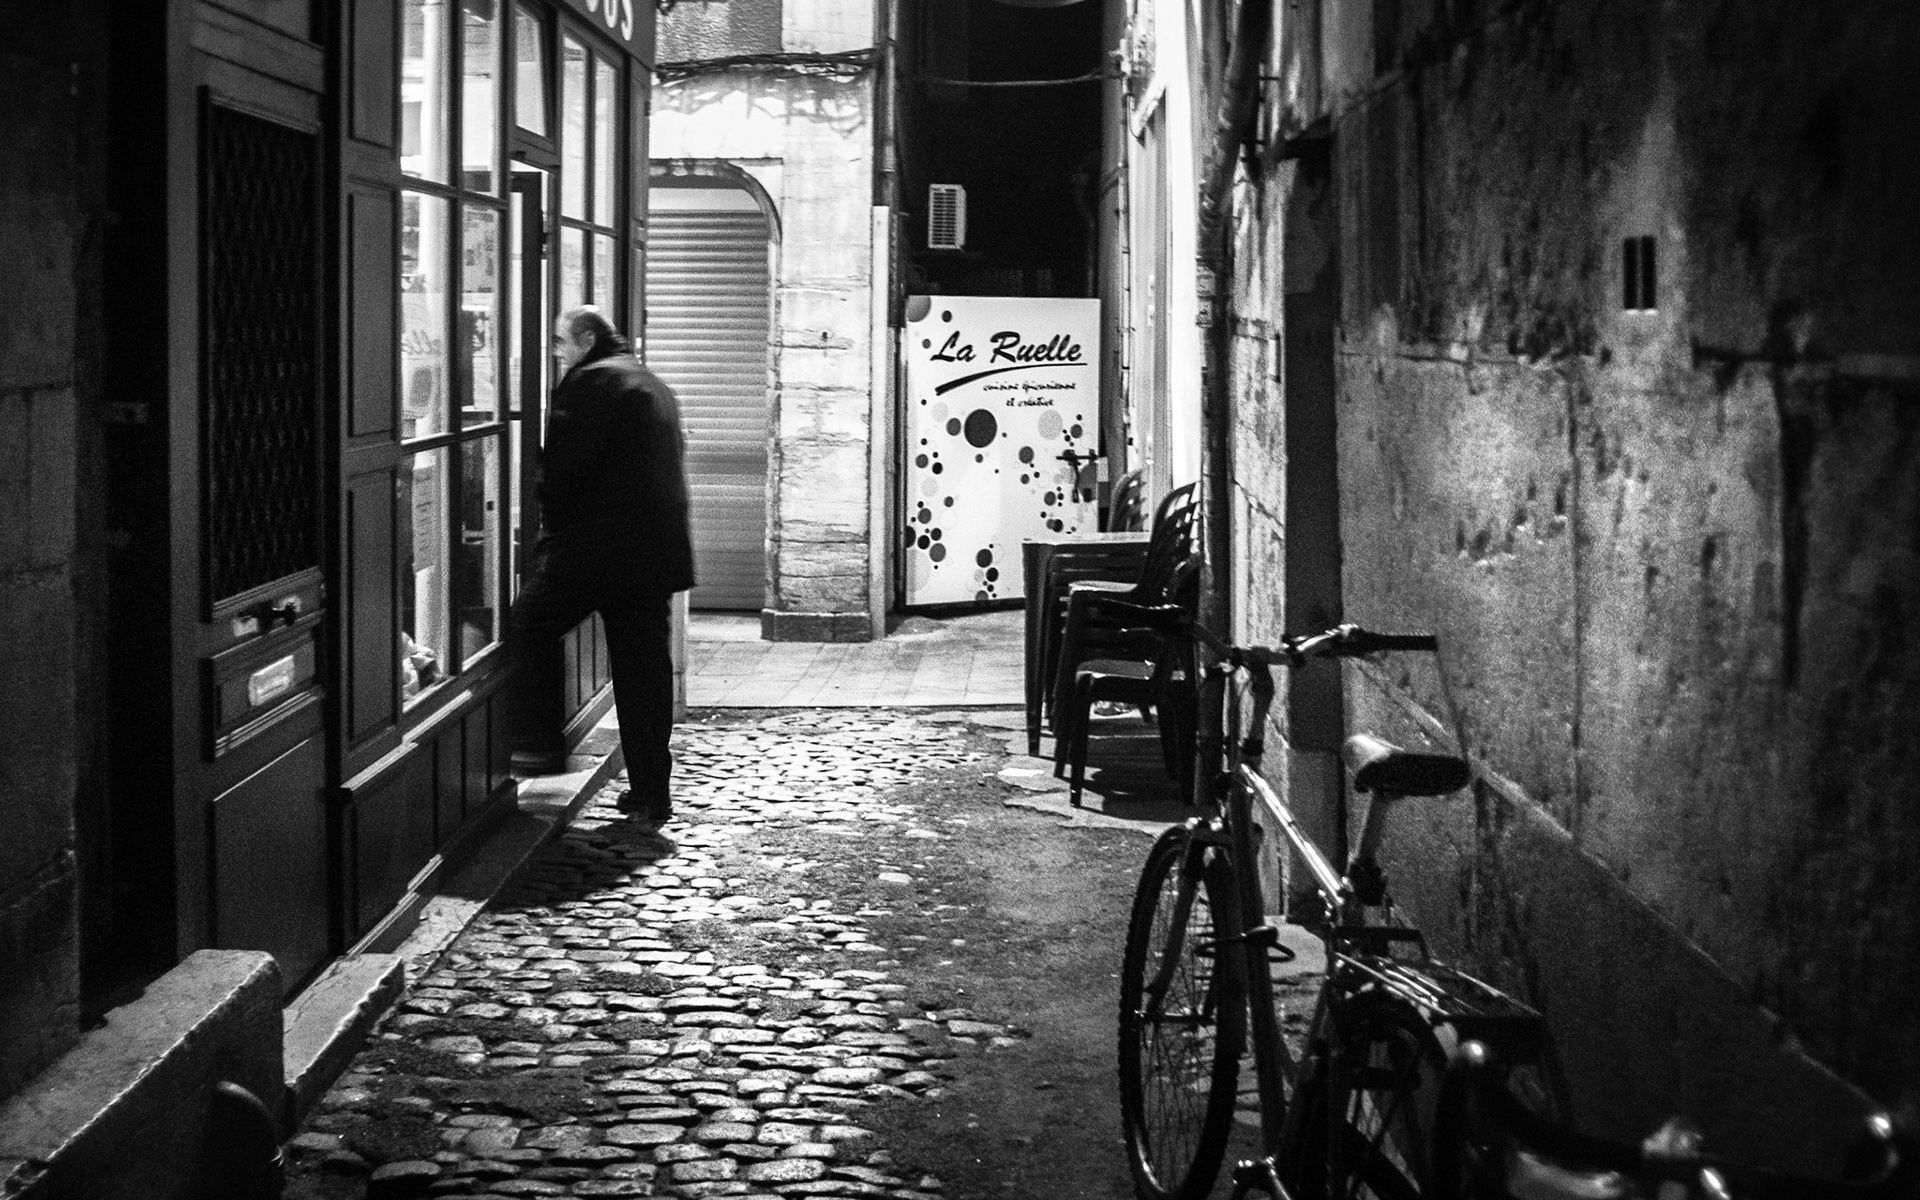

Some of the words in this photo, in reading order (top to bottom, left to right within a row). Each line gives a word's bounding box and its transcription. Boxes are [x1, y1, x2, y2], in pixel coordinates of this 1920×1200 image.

[930, 330, 977, 363] La
[989, 331, 1083, 363] Ruelle
[1005, 397, 1015, 407] et
